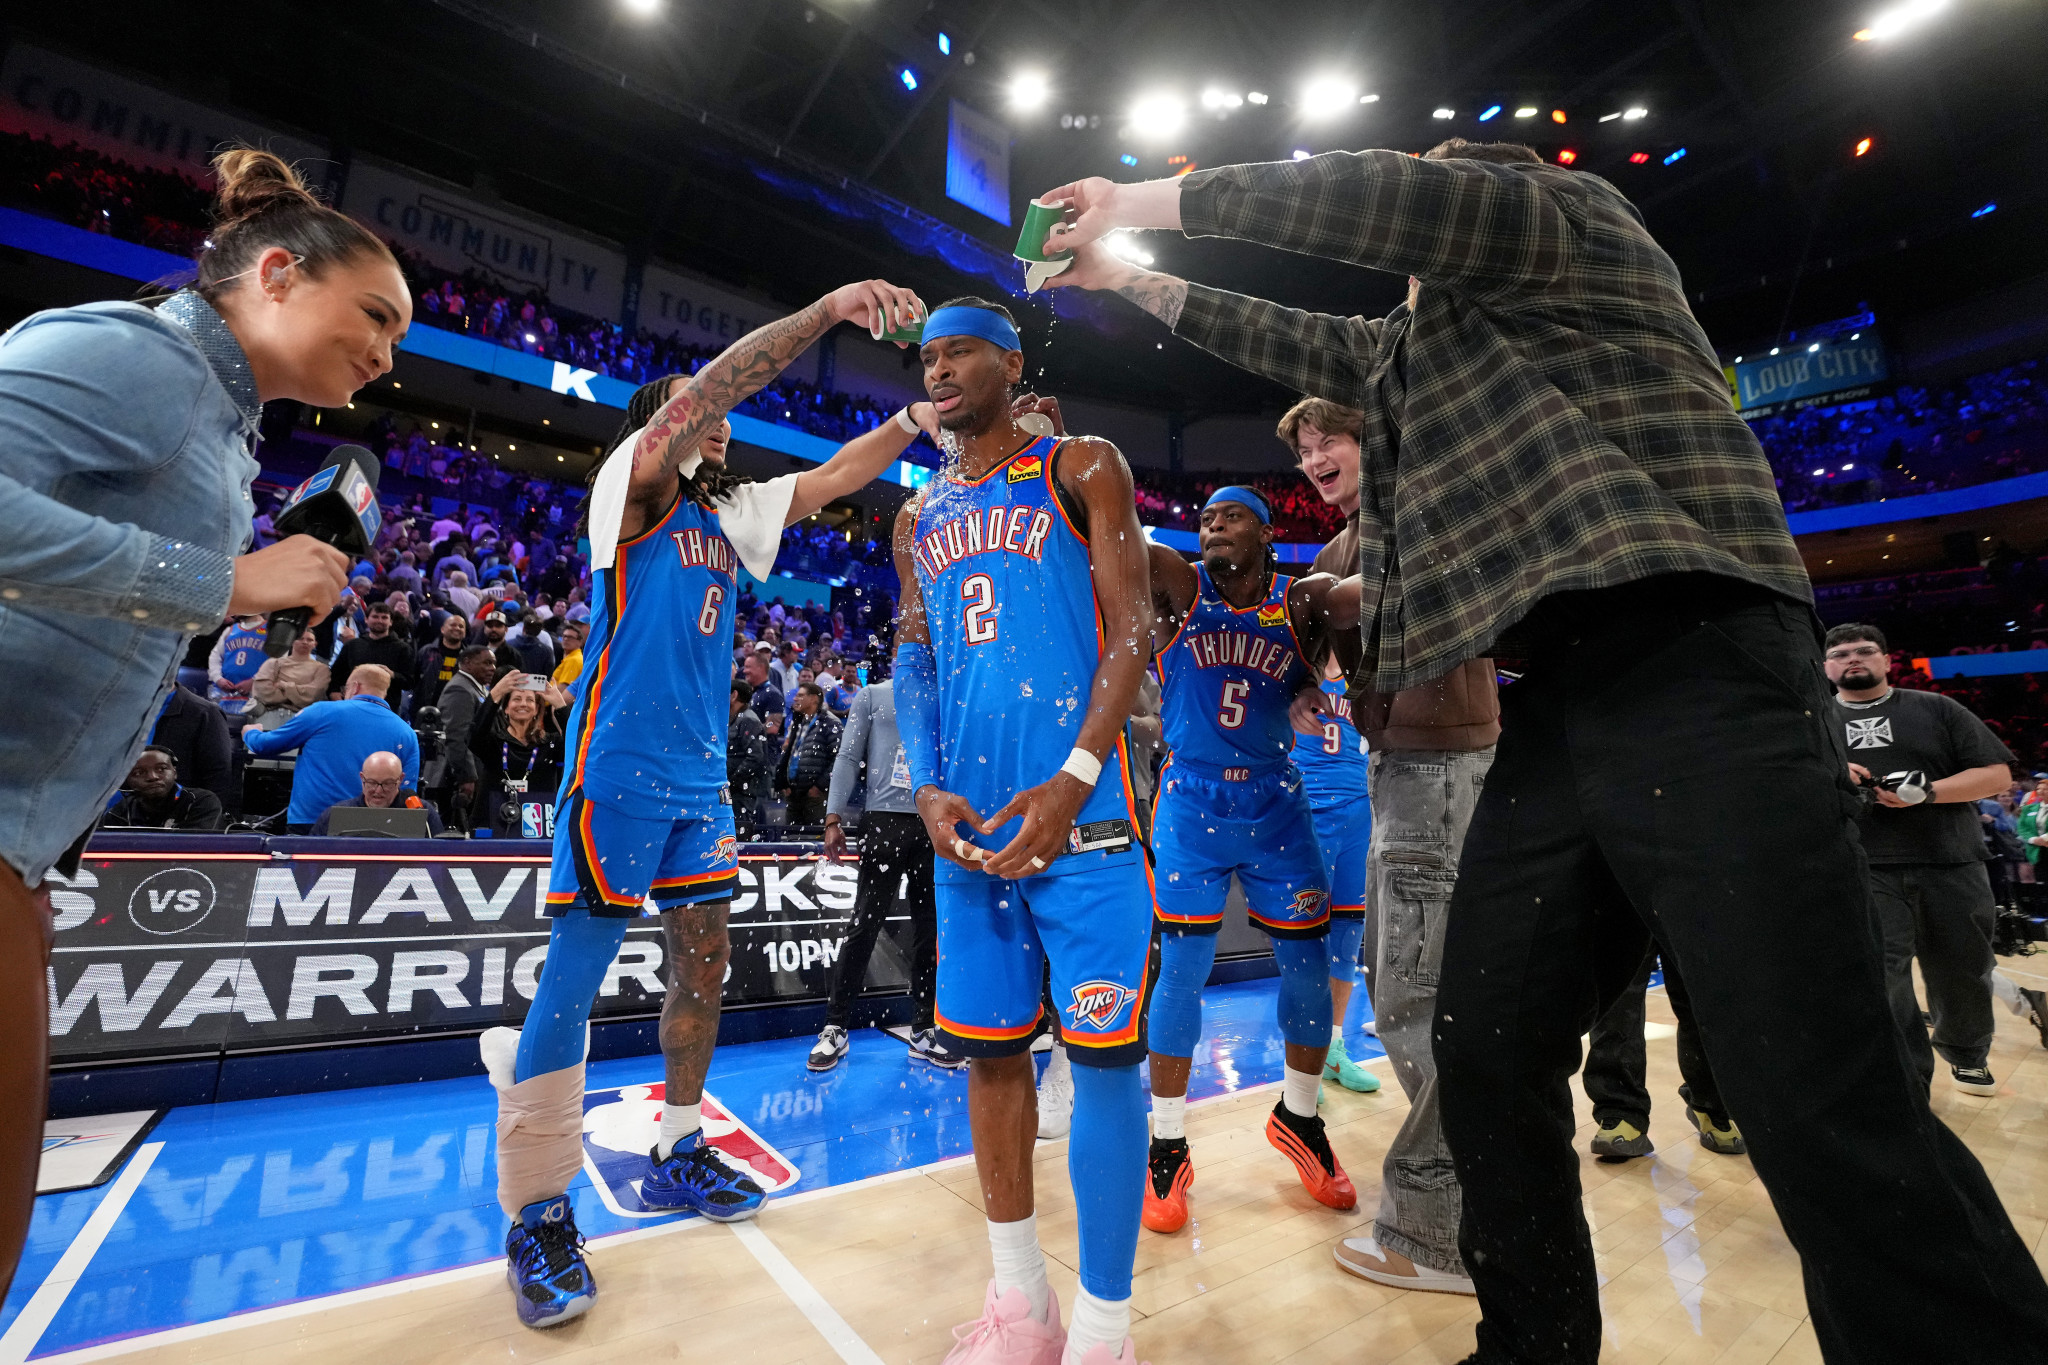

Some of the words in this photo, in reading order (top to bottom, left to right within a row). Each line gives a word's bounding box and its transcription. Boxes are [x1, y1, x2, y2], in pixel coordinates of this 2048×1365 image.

[551, 360, 598, 401] K
[1743, 356, 1811, 403] LOUD
[1818, 347, 1880, 379] CITY
[915, 505, 1053, 583] THUNDER
[699, 584, 724, 636] 6
[961, 573, 997, 646] 2
[235, 651, 248, 666] 8
[1187, 632, 1294, 680] THUNDER
[1218, 680, 1250, 729] 5
[1323, 721, 1341, 755] 9
[1223, 767, 1250, 782] OKC
[1297, 894, 1319, 914] OKC
[1076, 989, 1115, 1020] OKC
